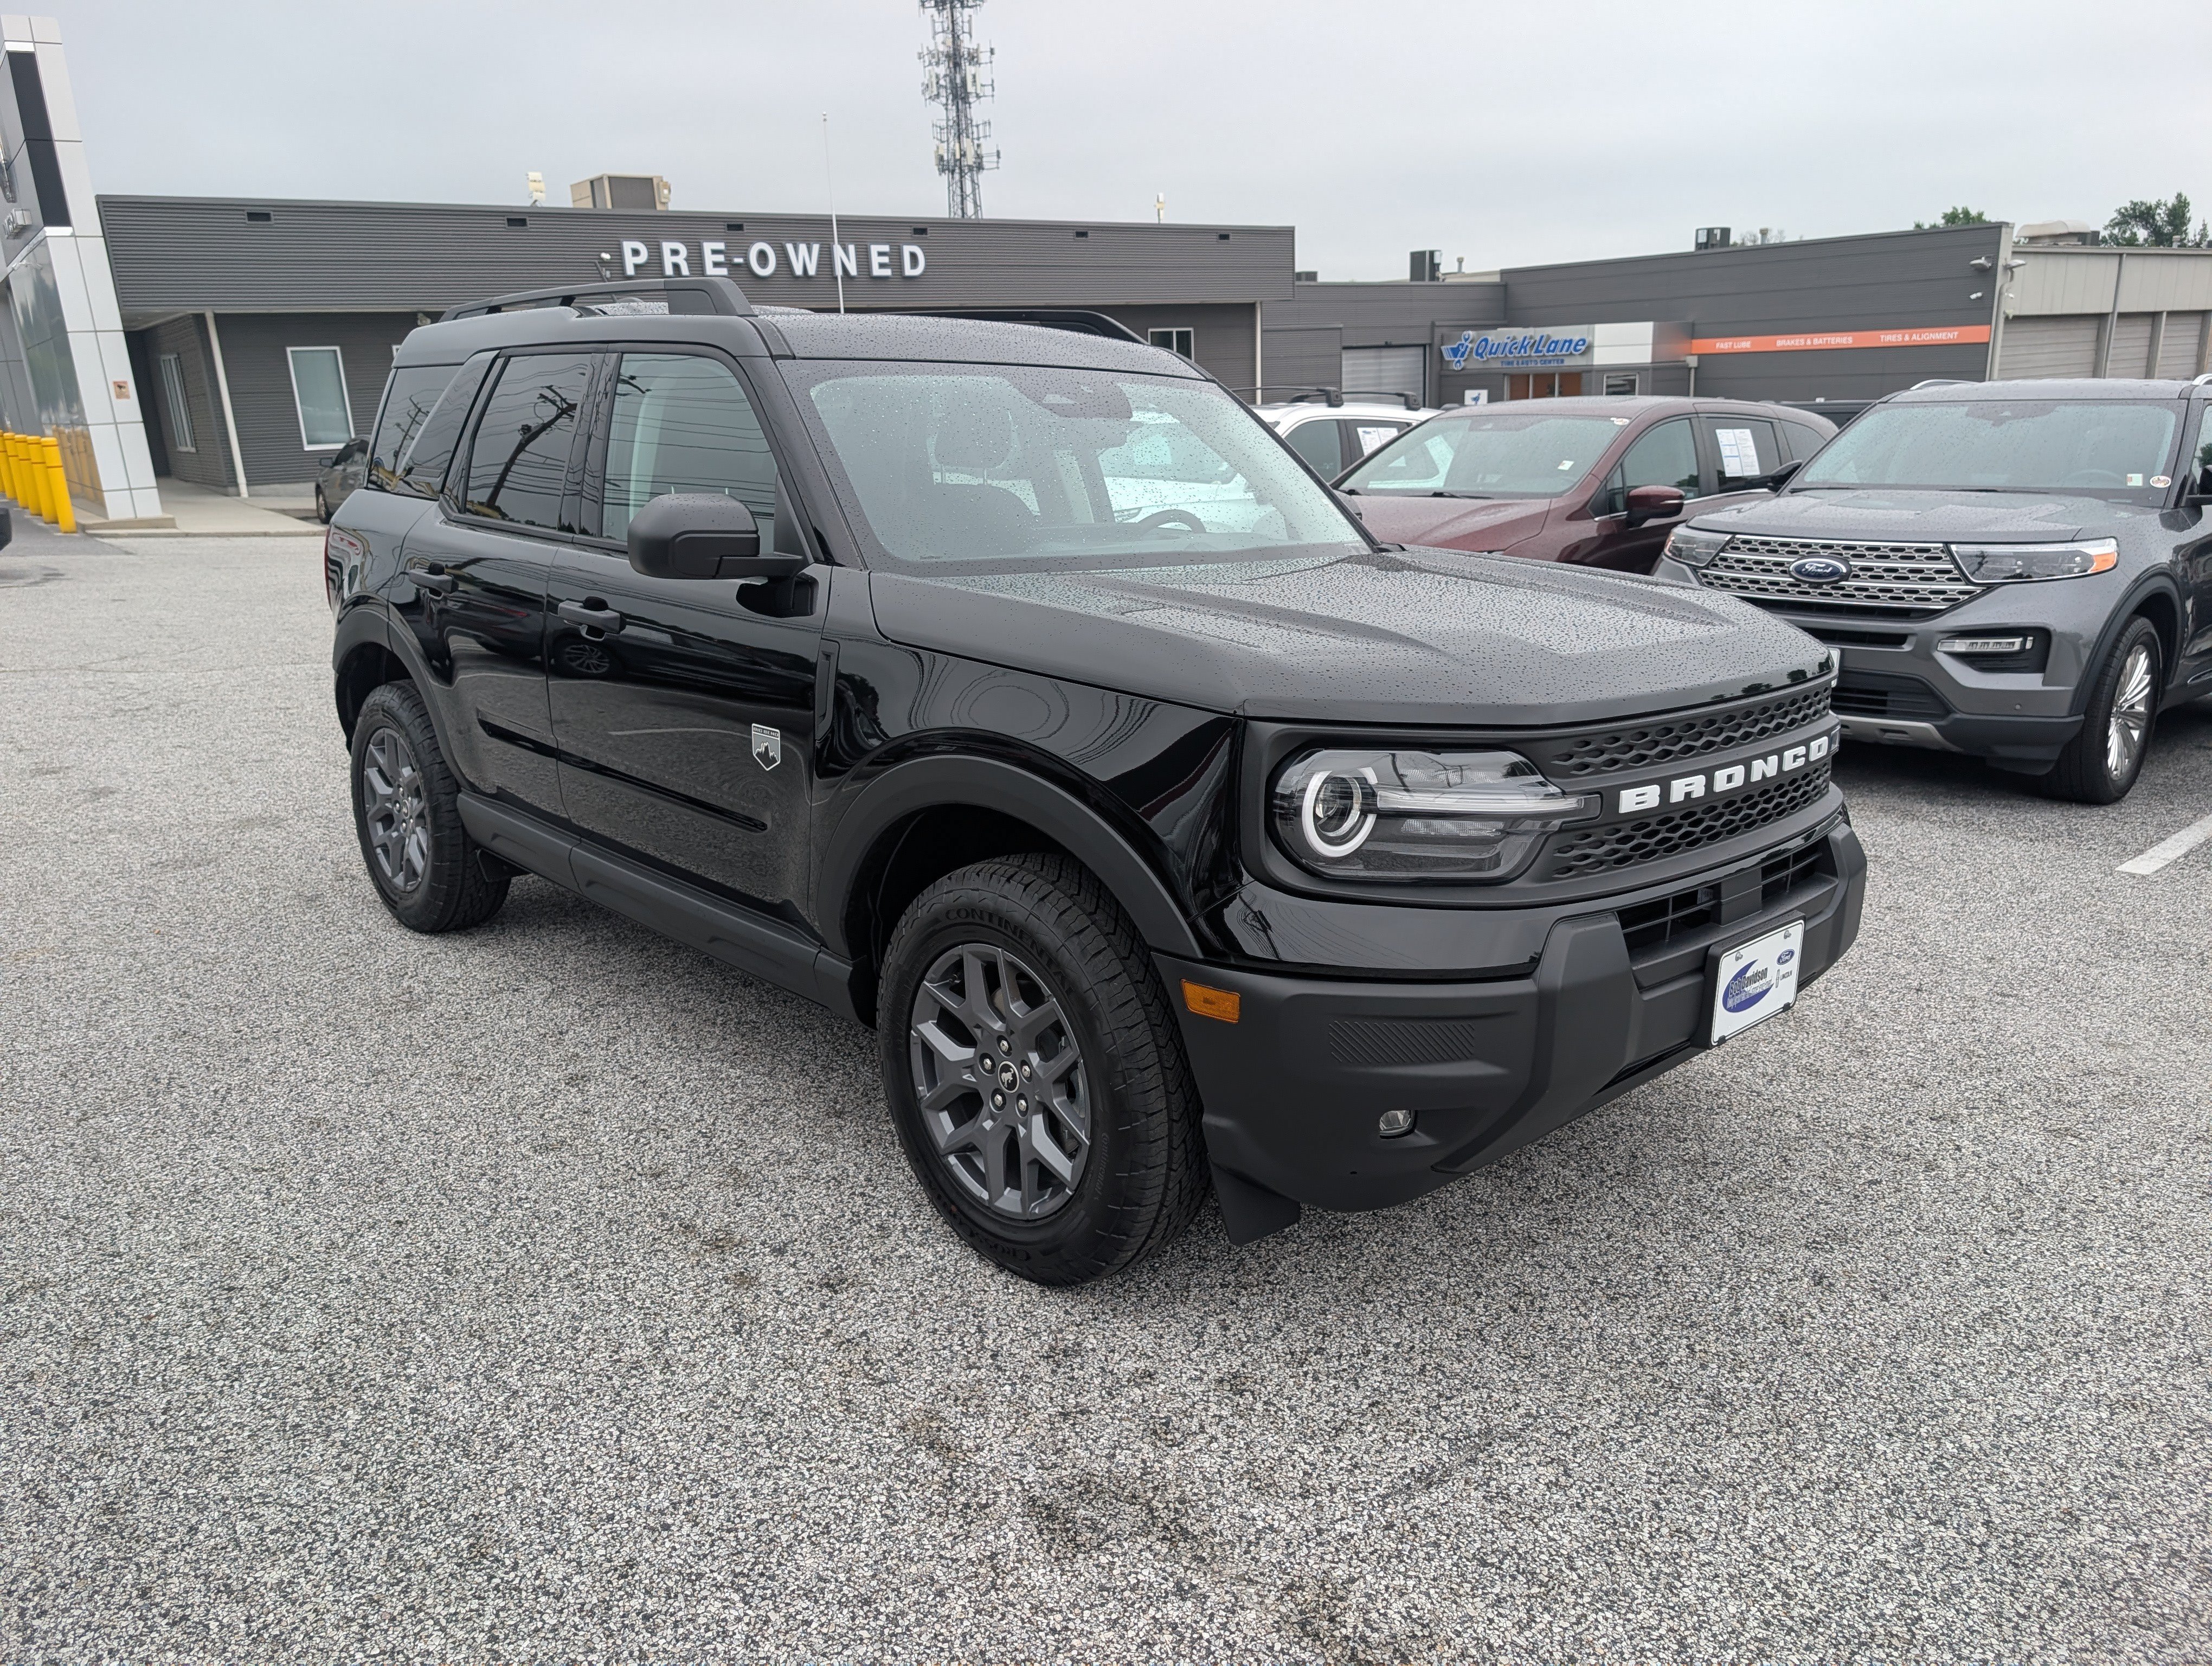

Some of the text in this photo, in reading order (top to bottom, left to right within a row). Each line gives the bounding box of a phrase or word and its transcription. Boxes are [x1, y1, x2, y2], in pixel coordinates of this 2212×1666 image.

[622, 240, 925, 277] PRE-OWNED
[1474, 334, 1588, 361] Quick Lane
[1716, 341, 1752, 349] FAST LUBE
[1777, 338, 1804, 347] BRAKES
[1813, 336, 1853, 345] BATTERIES
[1880, 334, 1902, 342] TIRES
[1912, 331, 1959, 341] ALIGNMENT
[1619, 735, 1829, 813] BRONCO
[945, 908, 1076, 997] CONTINENTAL
[1728, 977, 1742, 996] Bob
[1742, 967, 1768, 989] Davidson
